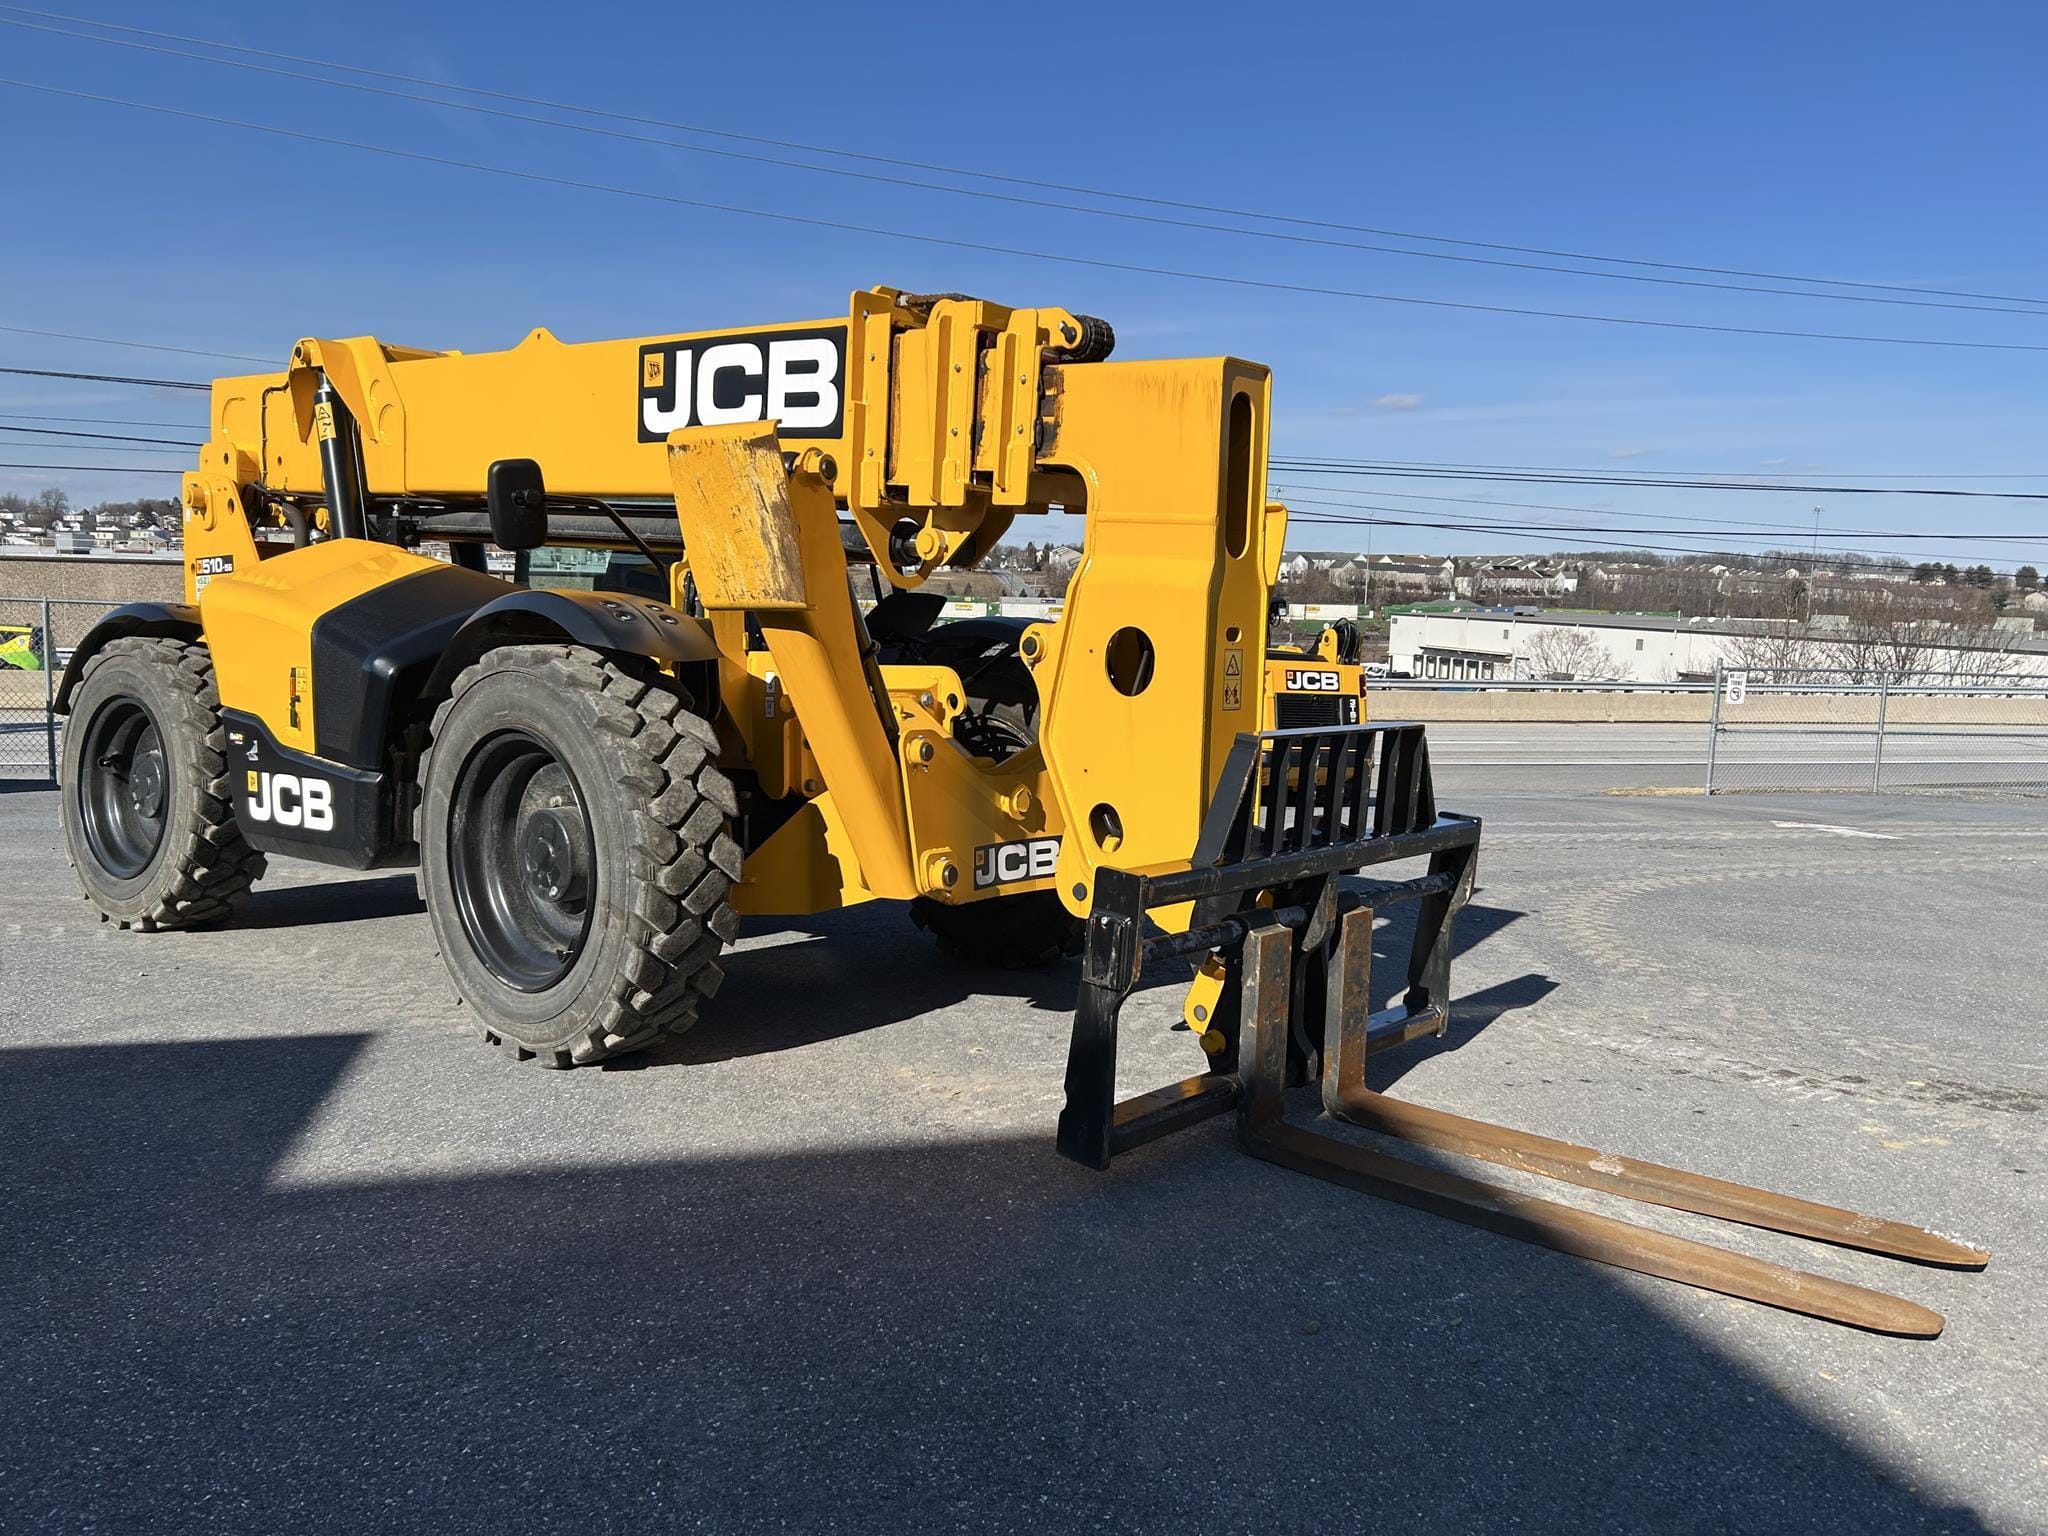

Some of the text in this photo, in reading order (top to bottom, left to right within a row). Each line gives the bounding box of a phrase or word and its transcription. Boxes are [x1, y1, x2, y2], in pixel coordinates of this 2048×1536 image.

[643, 339, 838, 433] JCB
[1287, 671, 1338, 690] JCB
[248, 772, 333, 831] JCB
[975, 840, 1060, 886] JCB
